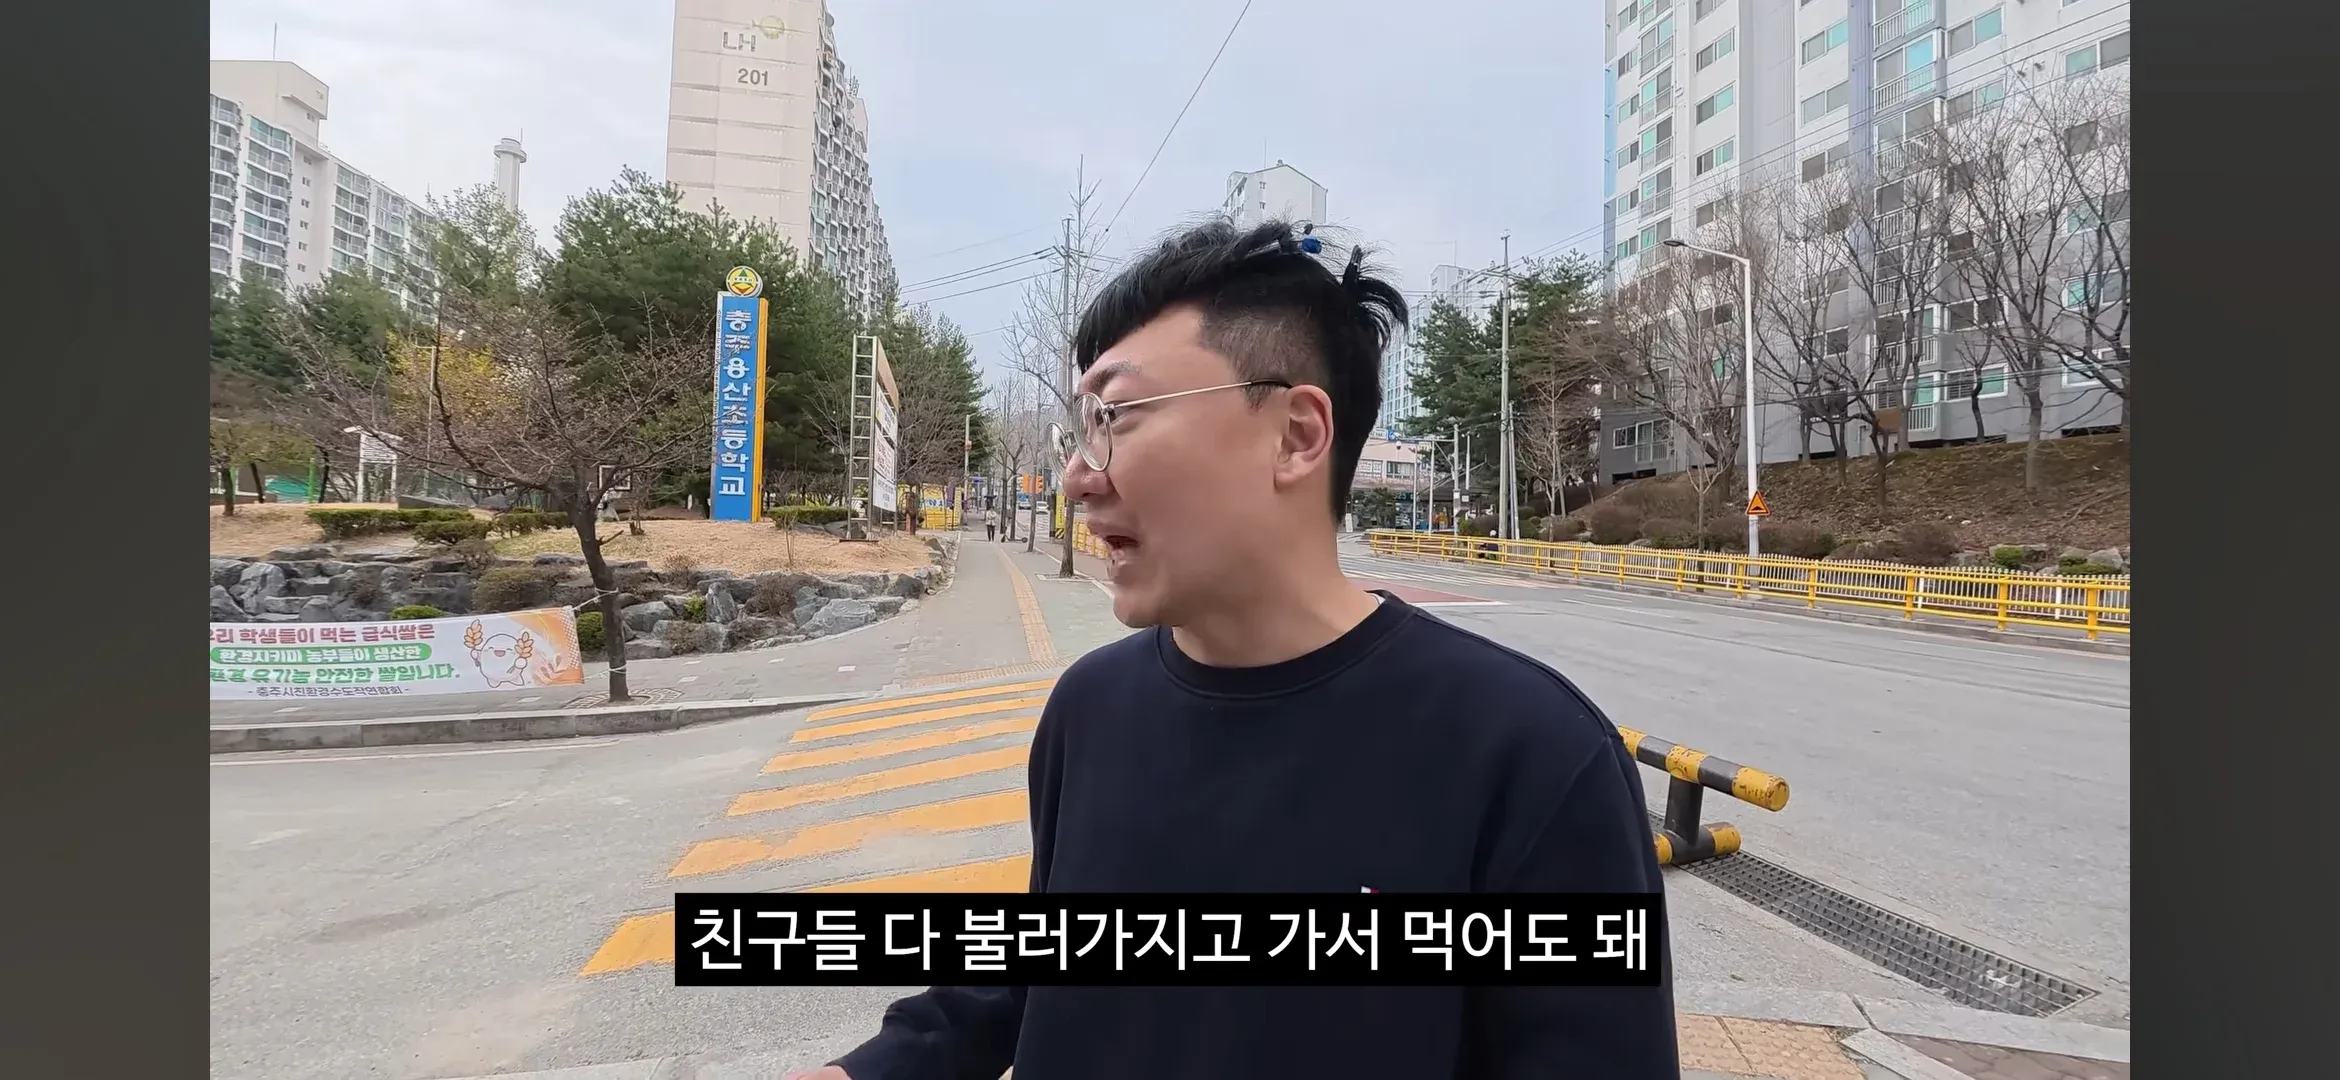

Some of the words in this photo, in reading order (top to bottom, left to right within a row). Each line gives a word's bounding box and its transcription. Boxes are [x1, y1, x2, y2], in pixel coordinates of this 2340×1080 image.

[723, 31, 756, 52] LH
[737, 68, 769, 86] 201
[718, 310, 752, 496] 충주용산초등학교
[238, 627, 315, 644] 학생들이
[320, 626, 356, 643] 먹는
[361, 623, 435, 642] 급식쌀은
[219, 648, 303, 663] 환경지키미
[306, 648, 369, 663] 농부들이
[373, 645, 422, 661] 생산한
[251, 668, 311, 684] 유기농
[315, 667, 374, 684] 안전한
[378, 663, 461, 682] 쌀입니다.
